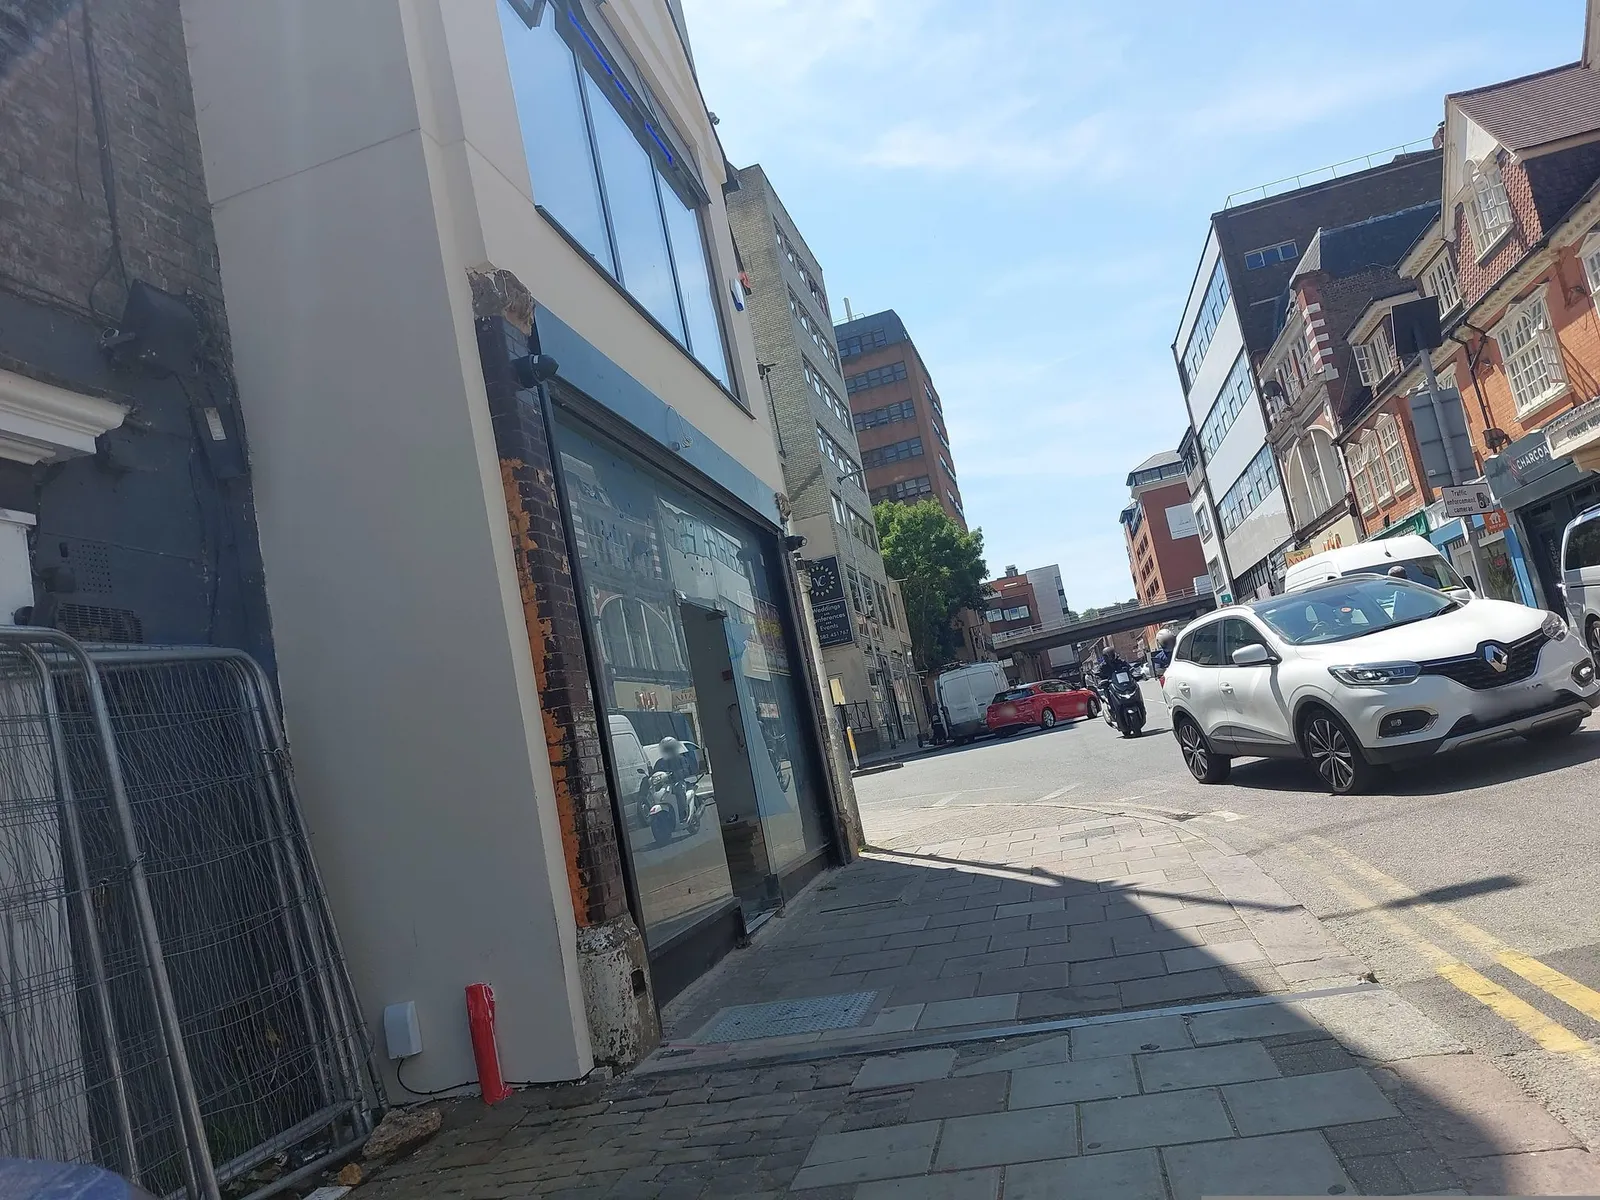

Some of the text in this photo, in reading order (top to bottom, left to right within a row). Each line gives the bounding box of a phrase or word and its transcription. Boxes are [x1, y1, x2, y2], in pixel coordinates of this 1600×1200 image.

[1516, 444, 1550, 470] CHARCOA
[1447, 497, 1476, 505] enforcement
[813, 604, 841, 613] Weddings
[815, 613, 846, 623] onferences
[820, 624, 839, 632] Events
